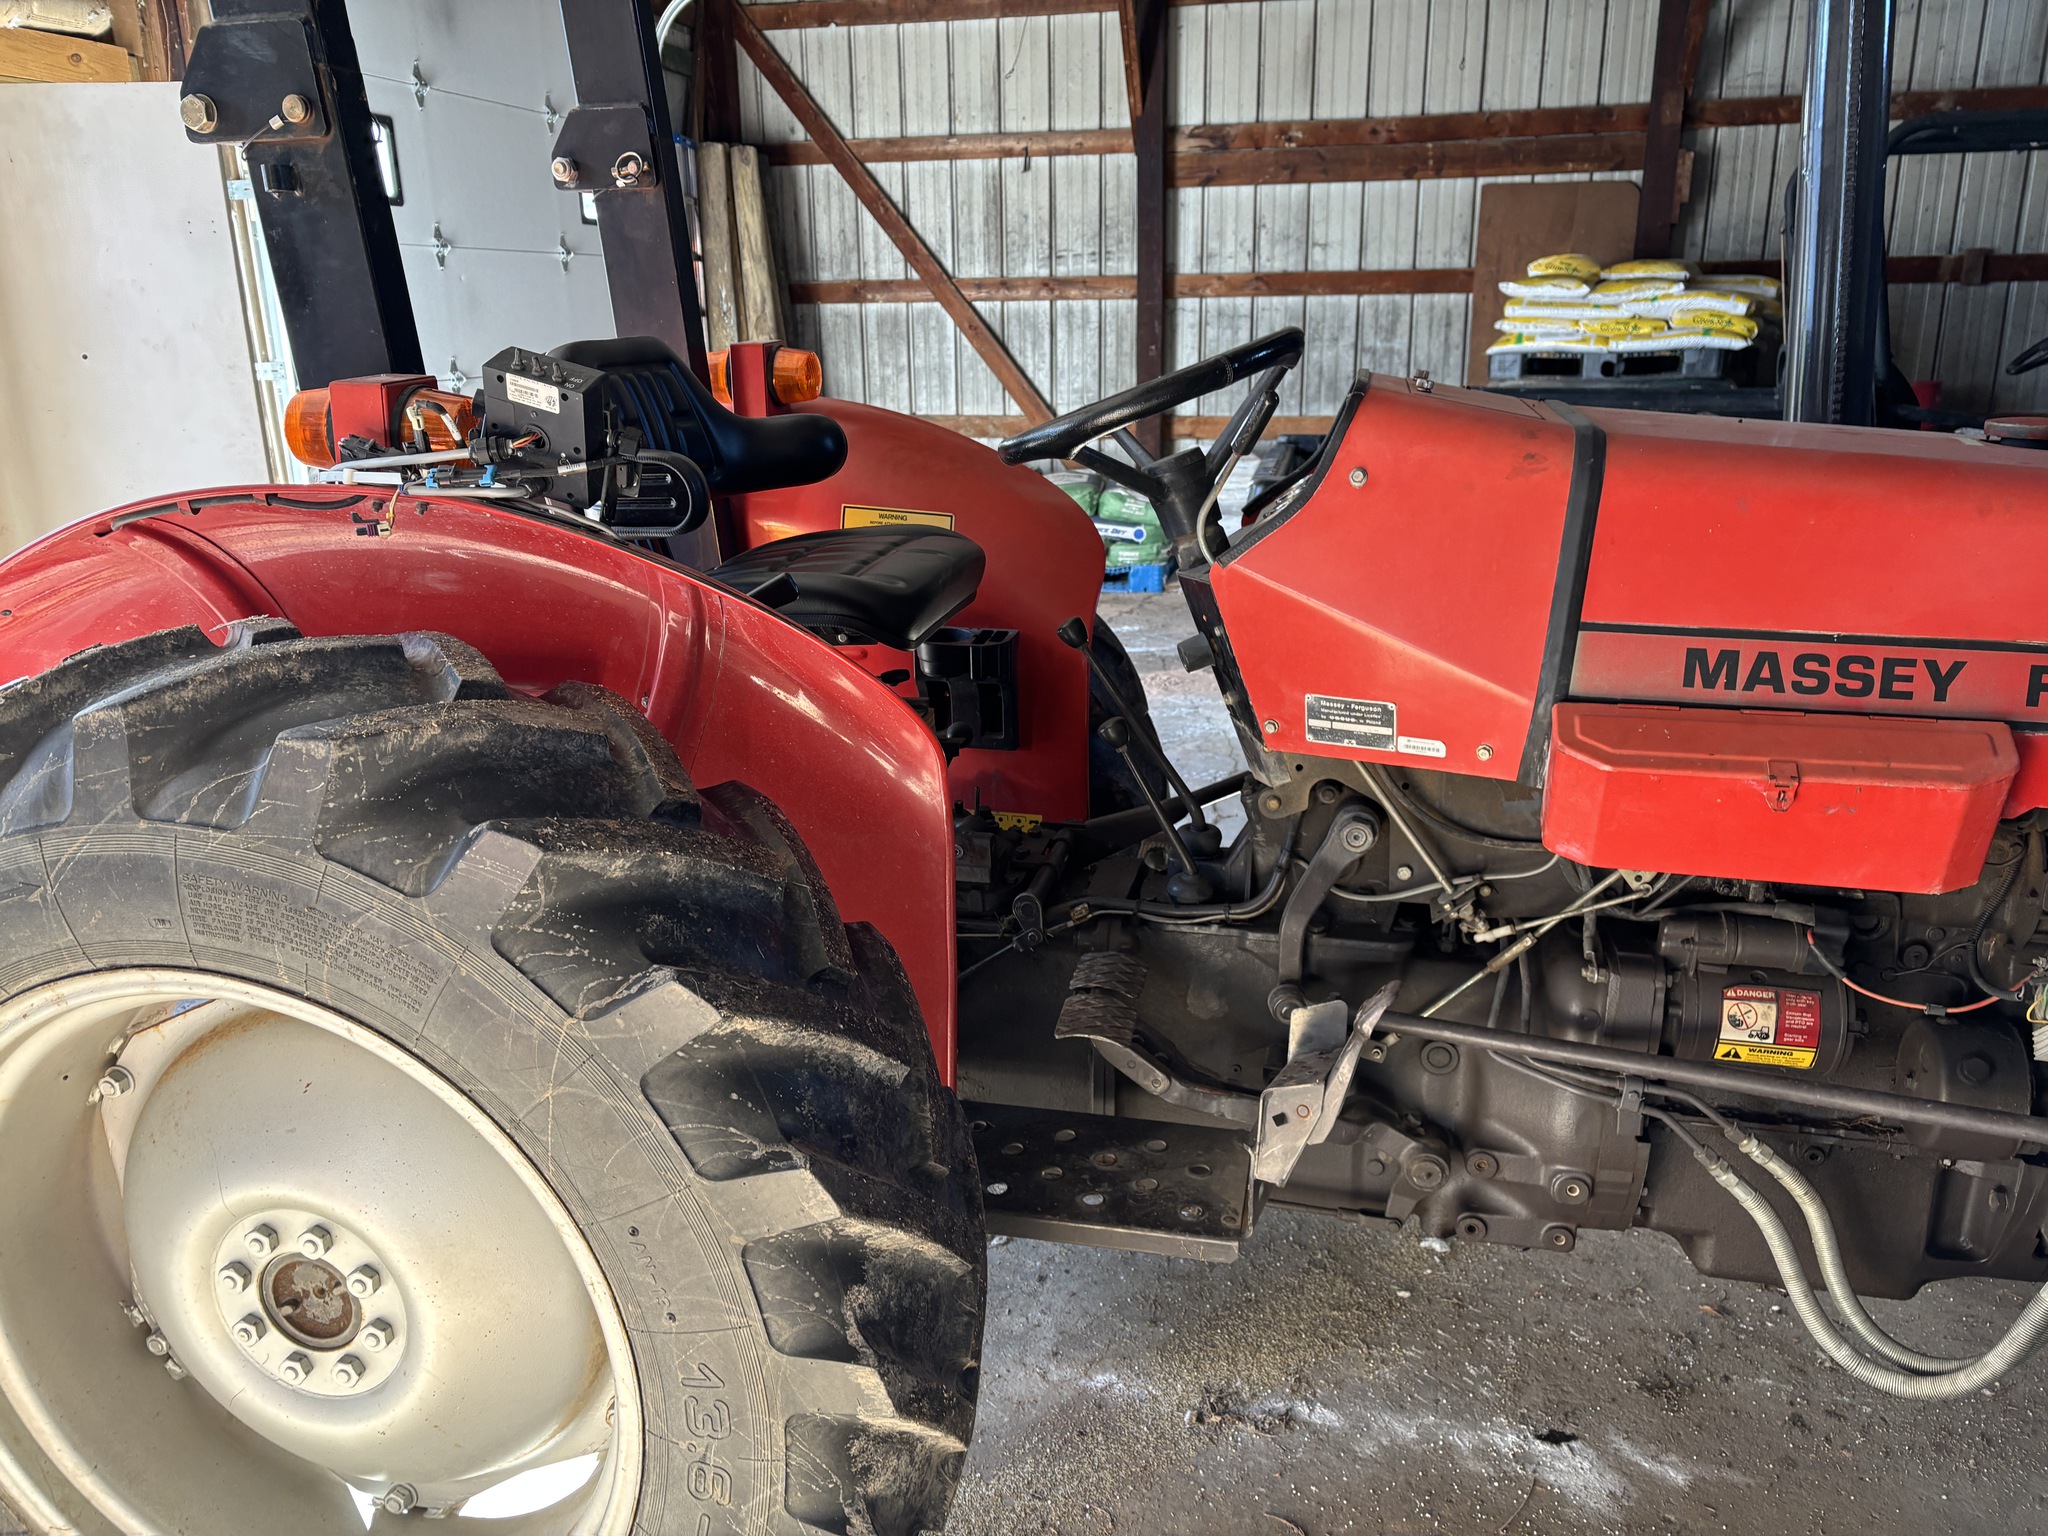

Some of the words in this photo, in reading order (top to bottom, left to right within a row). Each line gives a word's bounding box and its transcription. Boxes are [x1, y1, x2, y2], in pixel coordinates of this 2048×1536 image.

[878, 513, 908, 521] WARNING
[1682, 647, 1968, 703] MASSEY
[1320, 699, 1345, 709] Massey
[1351, 703, 1382, 712] Ferguson
[182, 872, 226, 886] SAFETY
[368, 934, 385, 946] MAY
[189, 906, 213, 916] NEVER
[188, 891, 202, 900] USE
[208, 894, 237, 907] SAFETY
[264, 908, 275, 916] OR
[279, 912, 319, 932] SEPARATE
[343, 938, 358, 950] AND
[211, 917, 243, 930] FAILURE
[247, 924, 263, 935] DUE
[267, 930, 277, 939] TO
[328, 922, 343, 935] DUE
[345, 930, 355, 940] TO
[189, 899, 202, 907] AIR
[246, 910, 283, 926] SPECIALLY
[286, 921, 316, 938] TRAINED
[353, 950, 381, 969] SHOULD
[383, 965, 407, 983] MOUNT
[1736, 989, 1775, 999] DANGER
[1748, 1047, 1794, 1057] WARNING
